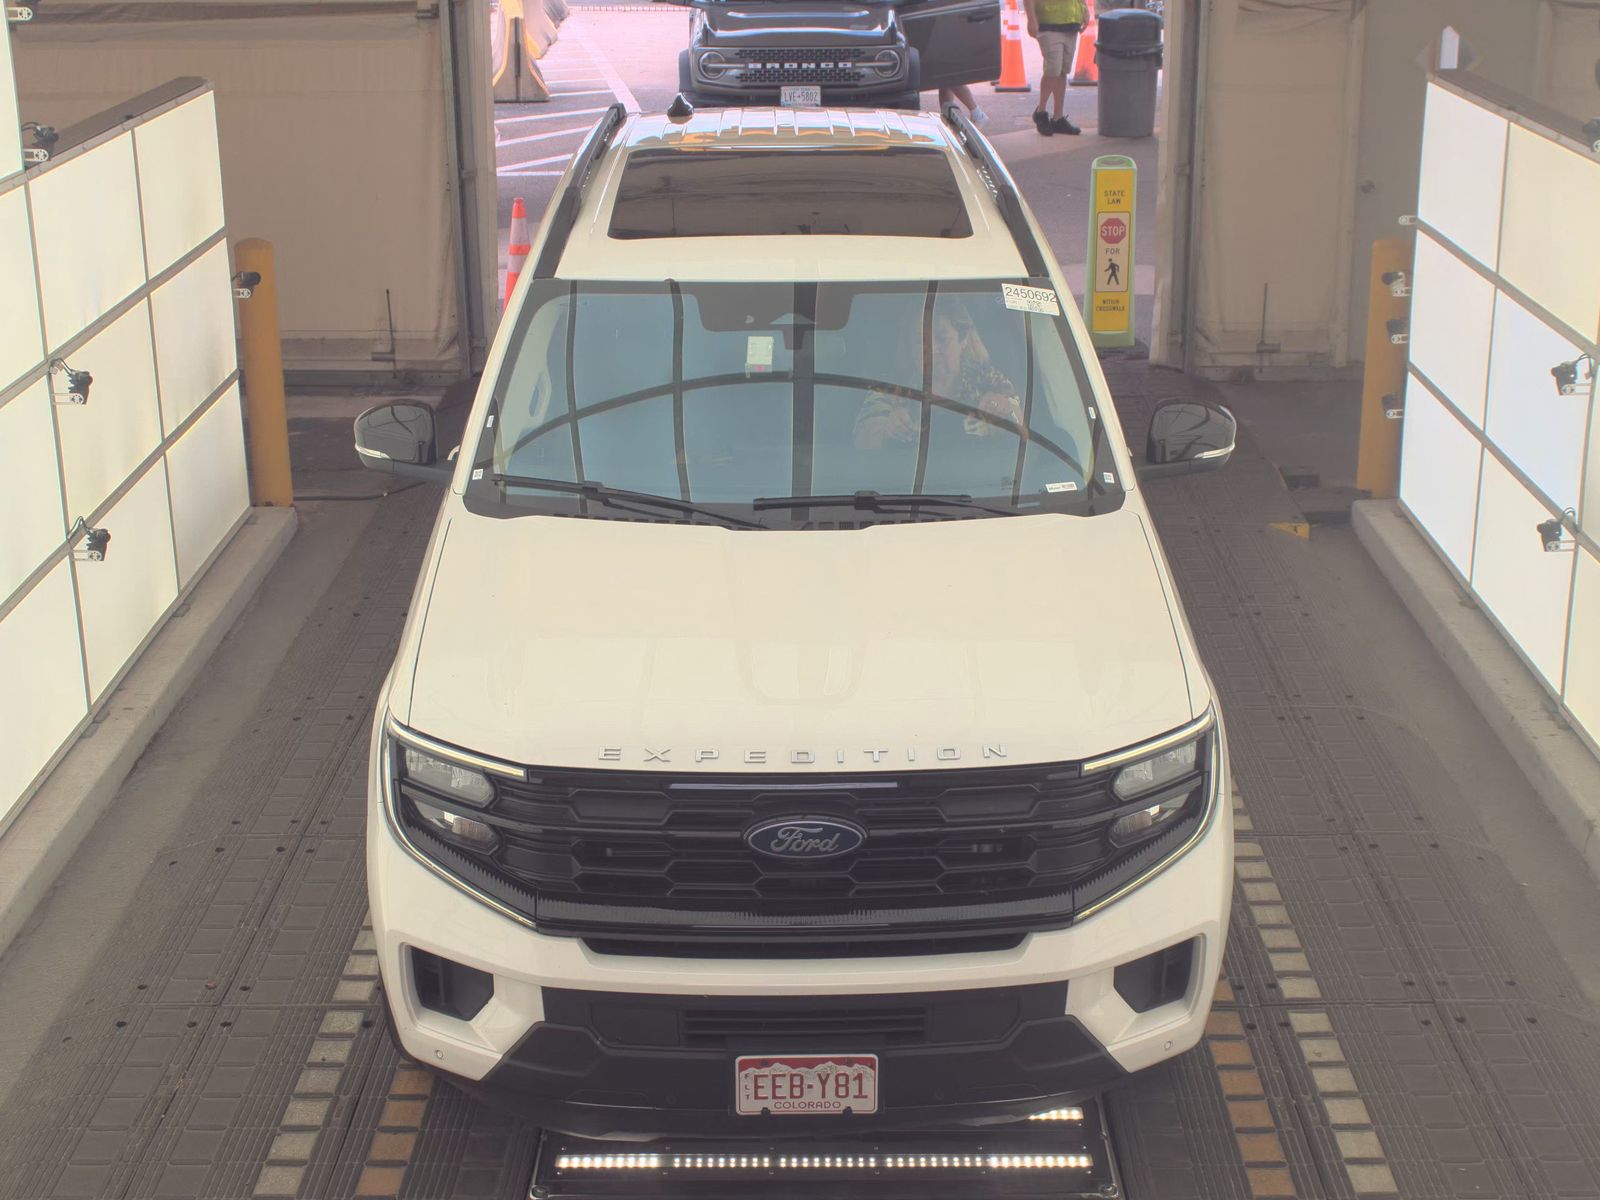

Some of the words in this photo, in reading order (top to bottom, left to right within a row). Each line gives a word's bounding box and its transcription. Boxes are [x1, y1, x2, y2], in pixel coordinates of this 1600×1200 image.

[1101, 225, 1126, 237] STOP
[1105, 247, 1120, 255] FOR
[1005, 286, 1057, 303] 2450692
[597, 743, 1008, 764] EXPEDITION
[769, 826, 840, 853] Ford
[753, 1072, 869, 1101] EEB-Y81
[773, 1101, 842, 1110] COLORADO
